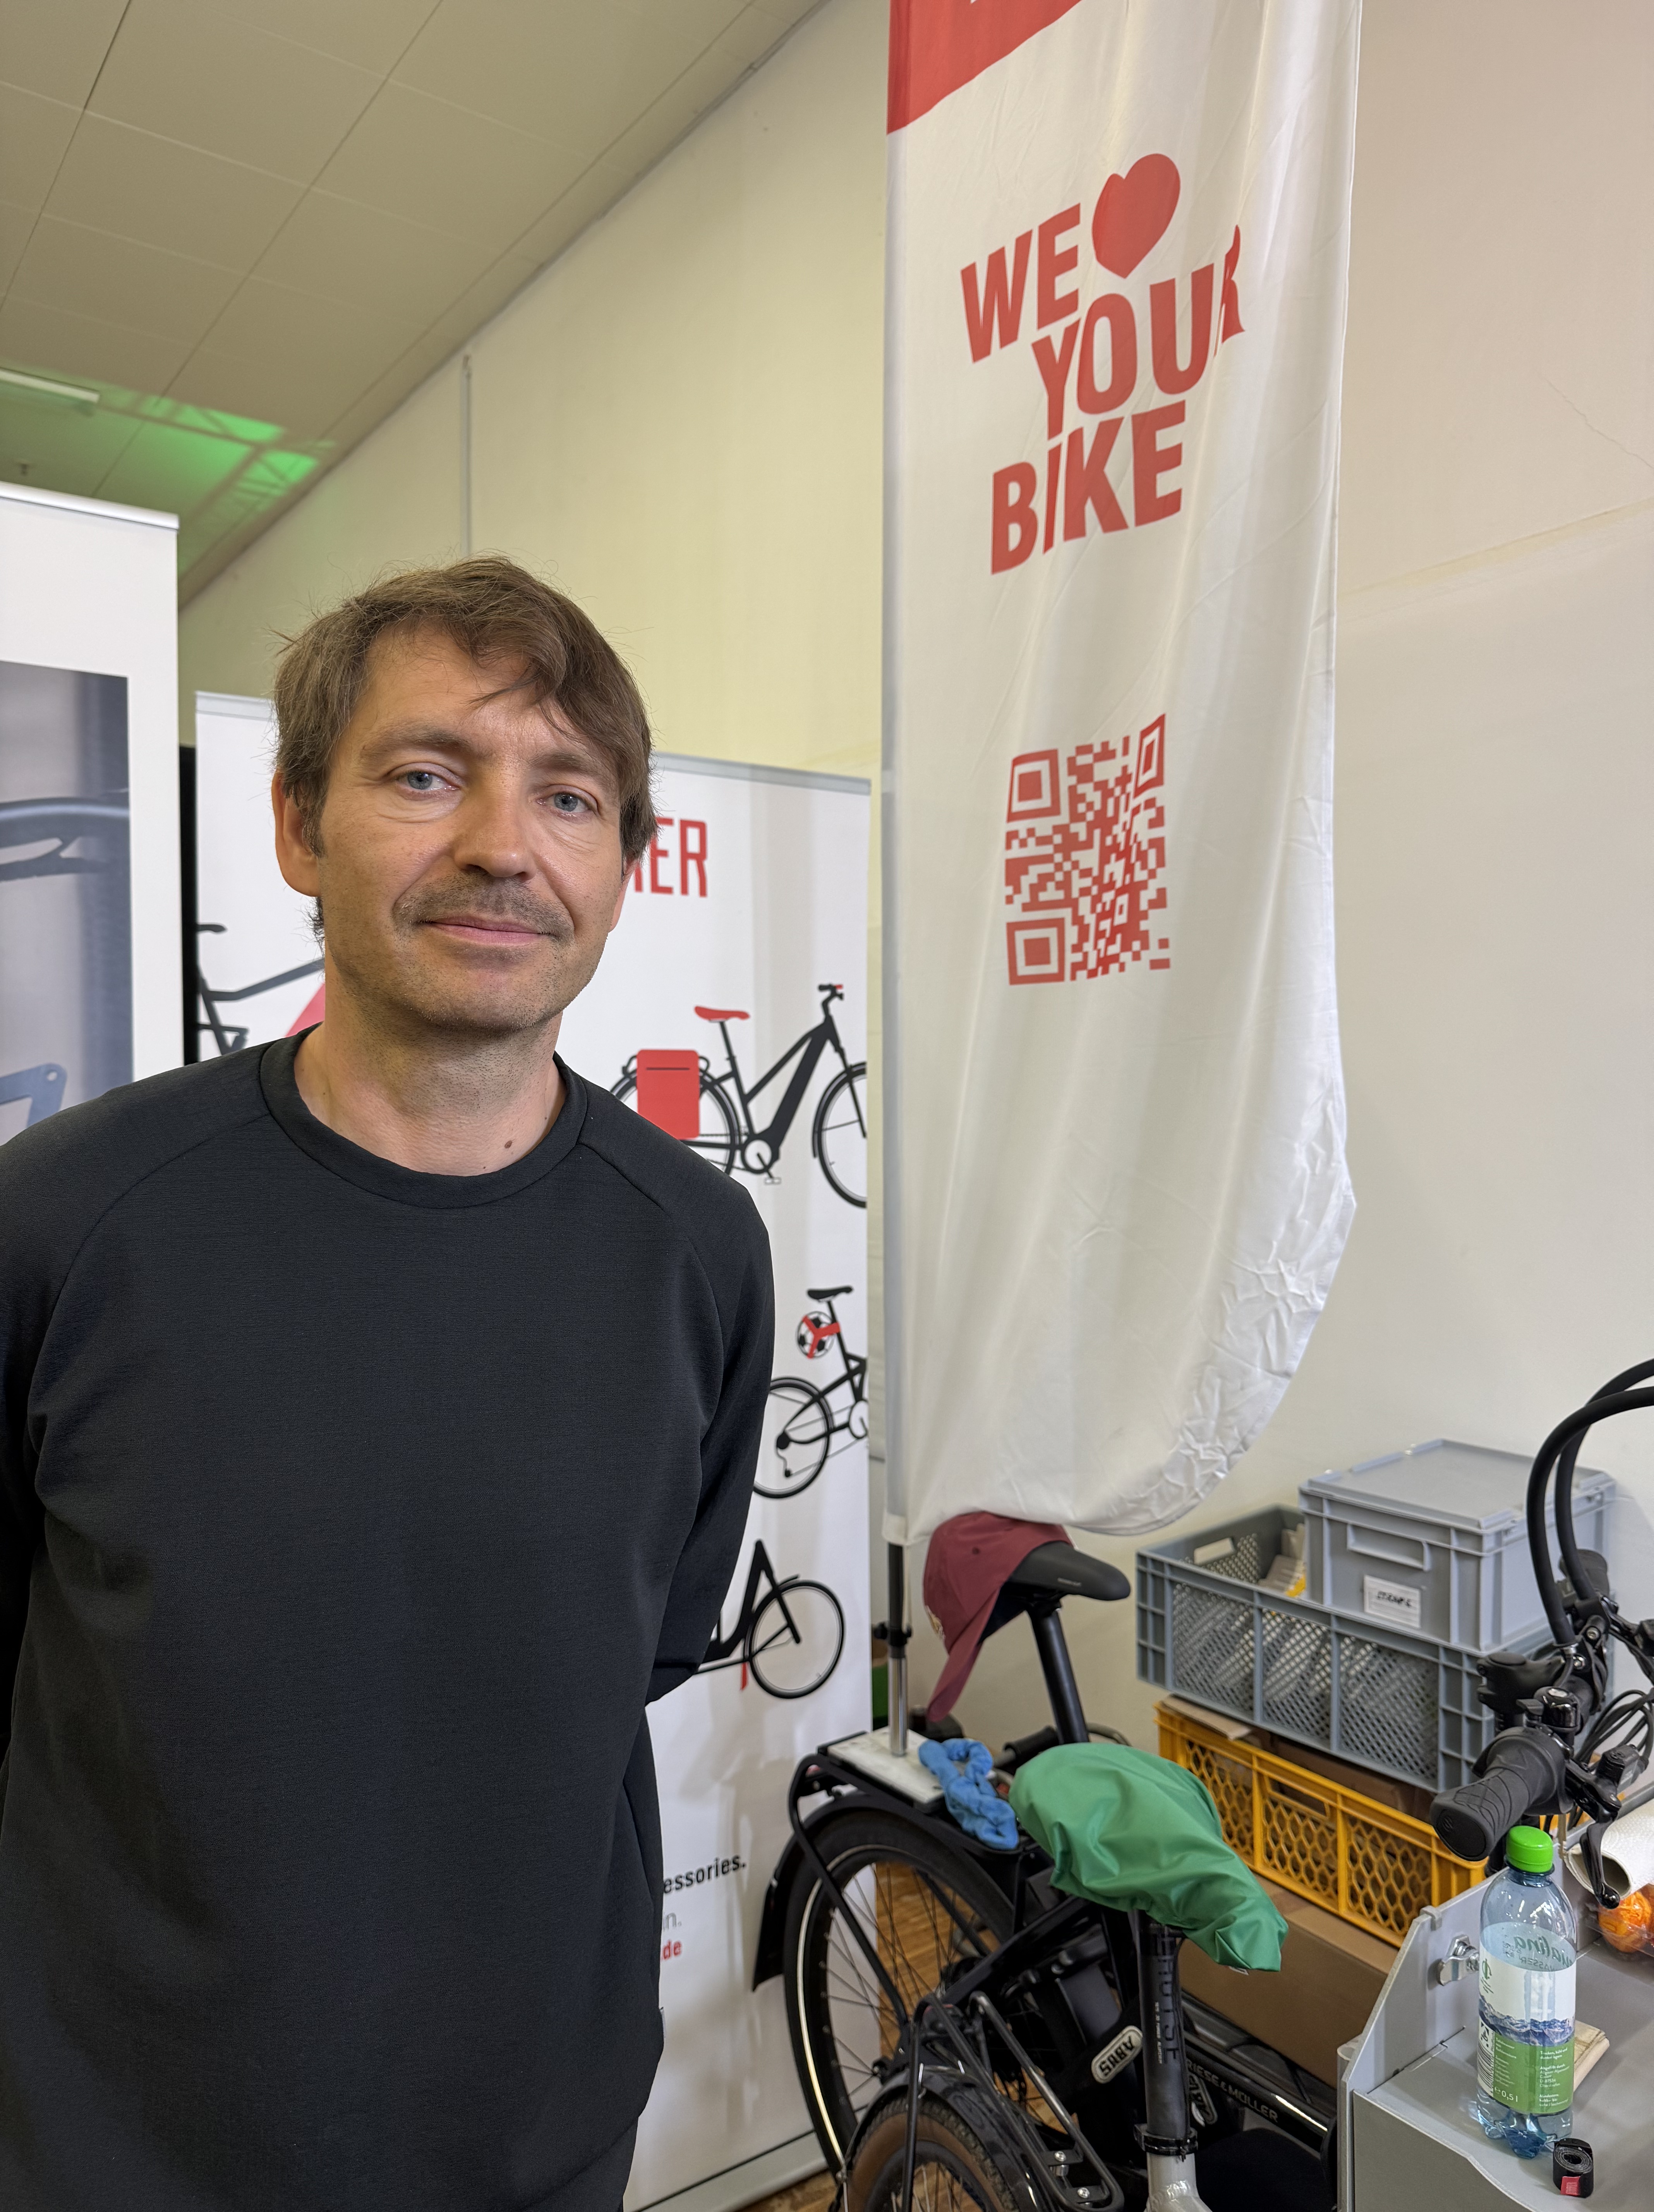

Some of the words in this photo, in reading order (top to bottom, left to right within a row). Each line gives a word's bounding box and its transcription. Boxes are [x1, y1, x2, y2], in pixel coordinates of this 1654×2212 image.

[960, 203, 1081, 363] WE
[1031, 225, 1246, 441] YOUR
[991, 400, 1186, 575] BIKE
[663, 1855, 746, 1894] essories.
[1100, 2036, 1134, 2076] ABUS
[1501, 2090, 1514, 2100] 0,5
